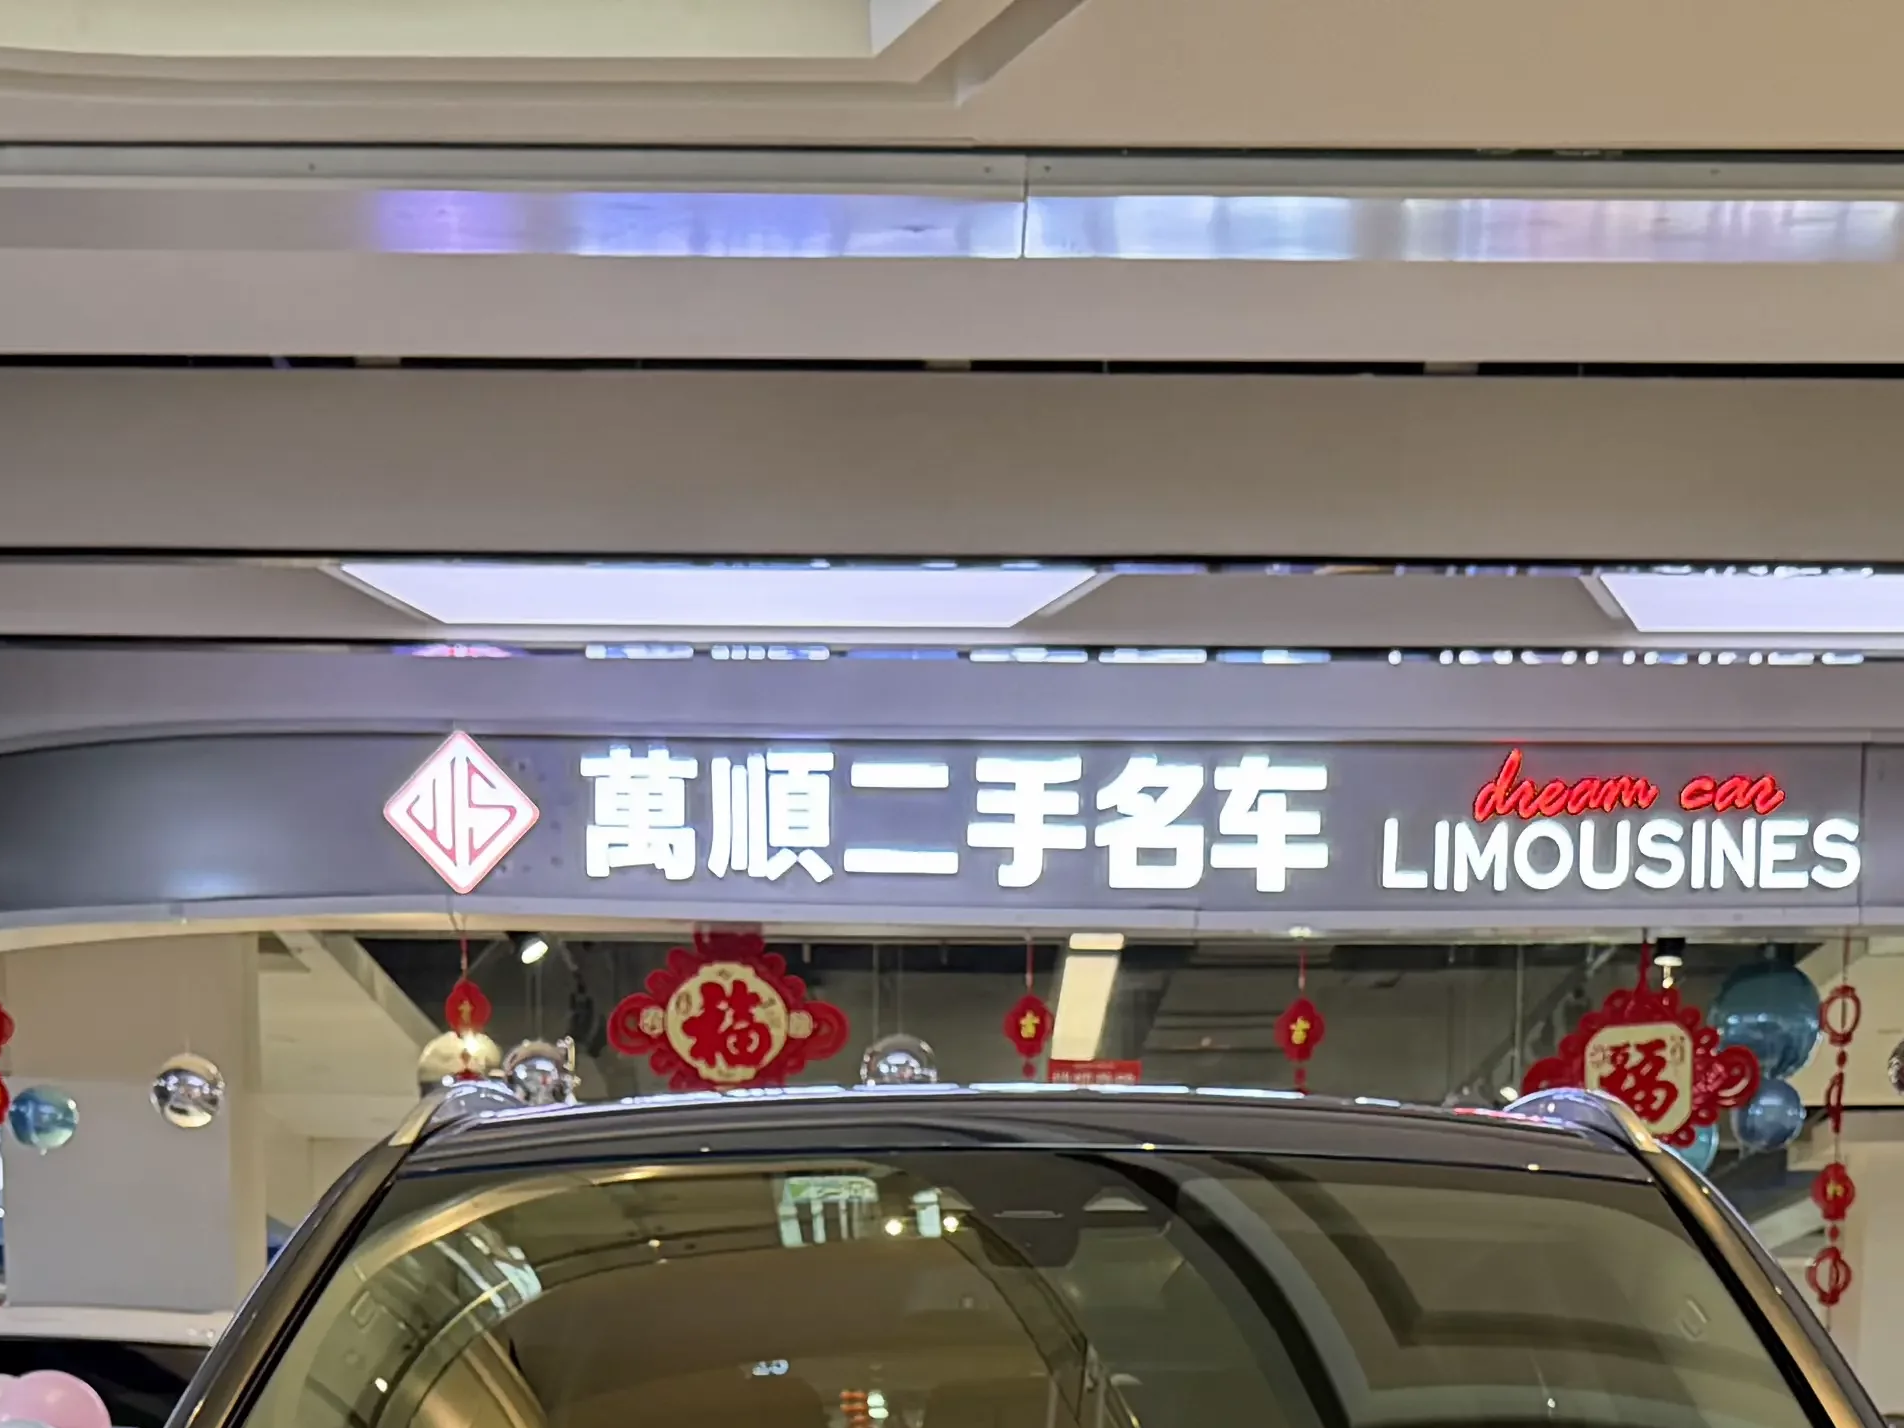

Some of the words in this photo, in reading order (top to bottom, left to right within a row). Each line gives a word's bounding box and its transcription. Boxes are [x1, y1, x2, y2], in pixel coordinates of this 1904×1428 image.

[580, 744, 1329, 893] 萬順二手名车
[1473, 748, 1658, 822] dream
[1679, 774, 1786, 815] car
[1382, 817, 1861, 891] LIMOUSINES
